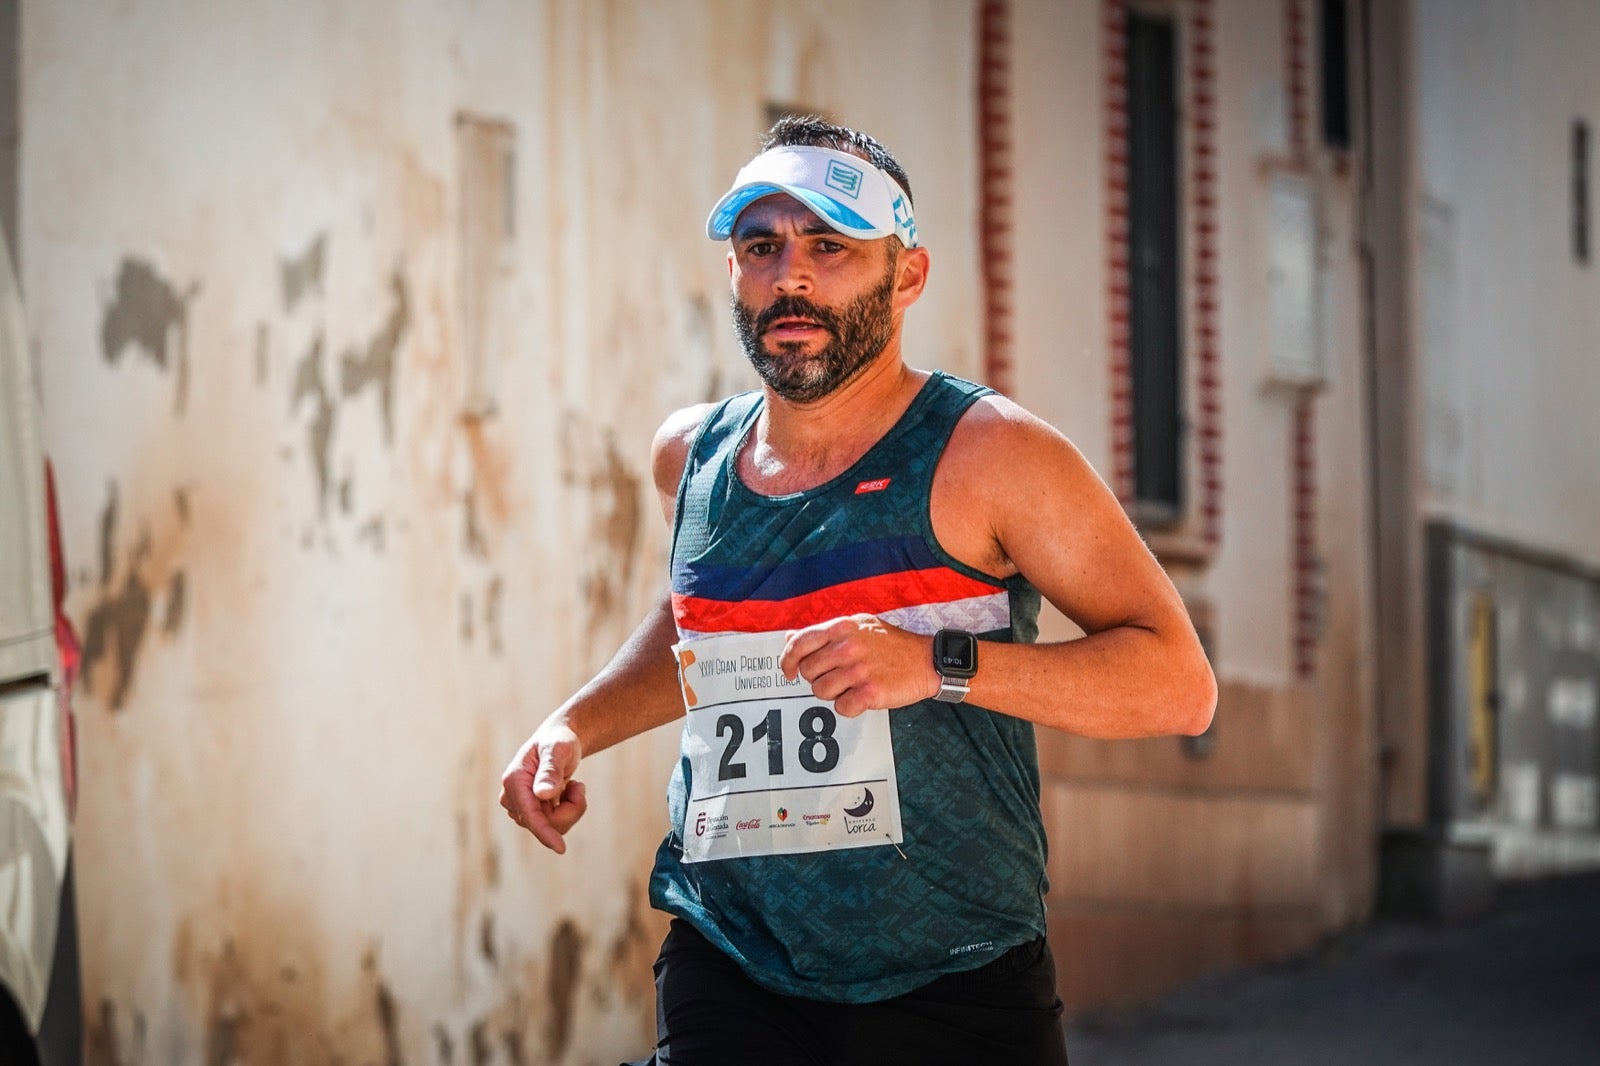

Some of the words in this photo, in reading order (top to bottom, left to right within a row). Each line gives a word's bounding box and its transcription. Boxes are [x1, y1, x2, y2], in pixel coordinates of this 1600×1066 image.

[740, 656, 772, 672] PREMIO
[734, 676, 772, 690] UNIVERSO
[715, 706, 840, 782] 218
